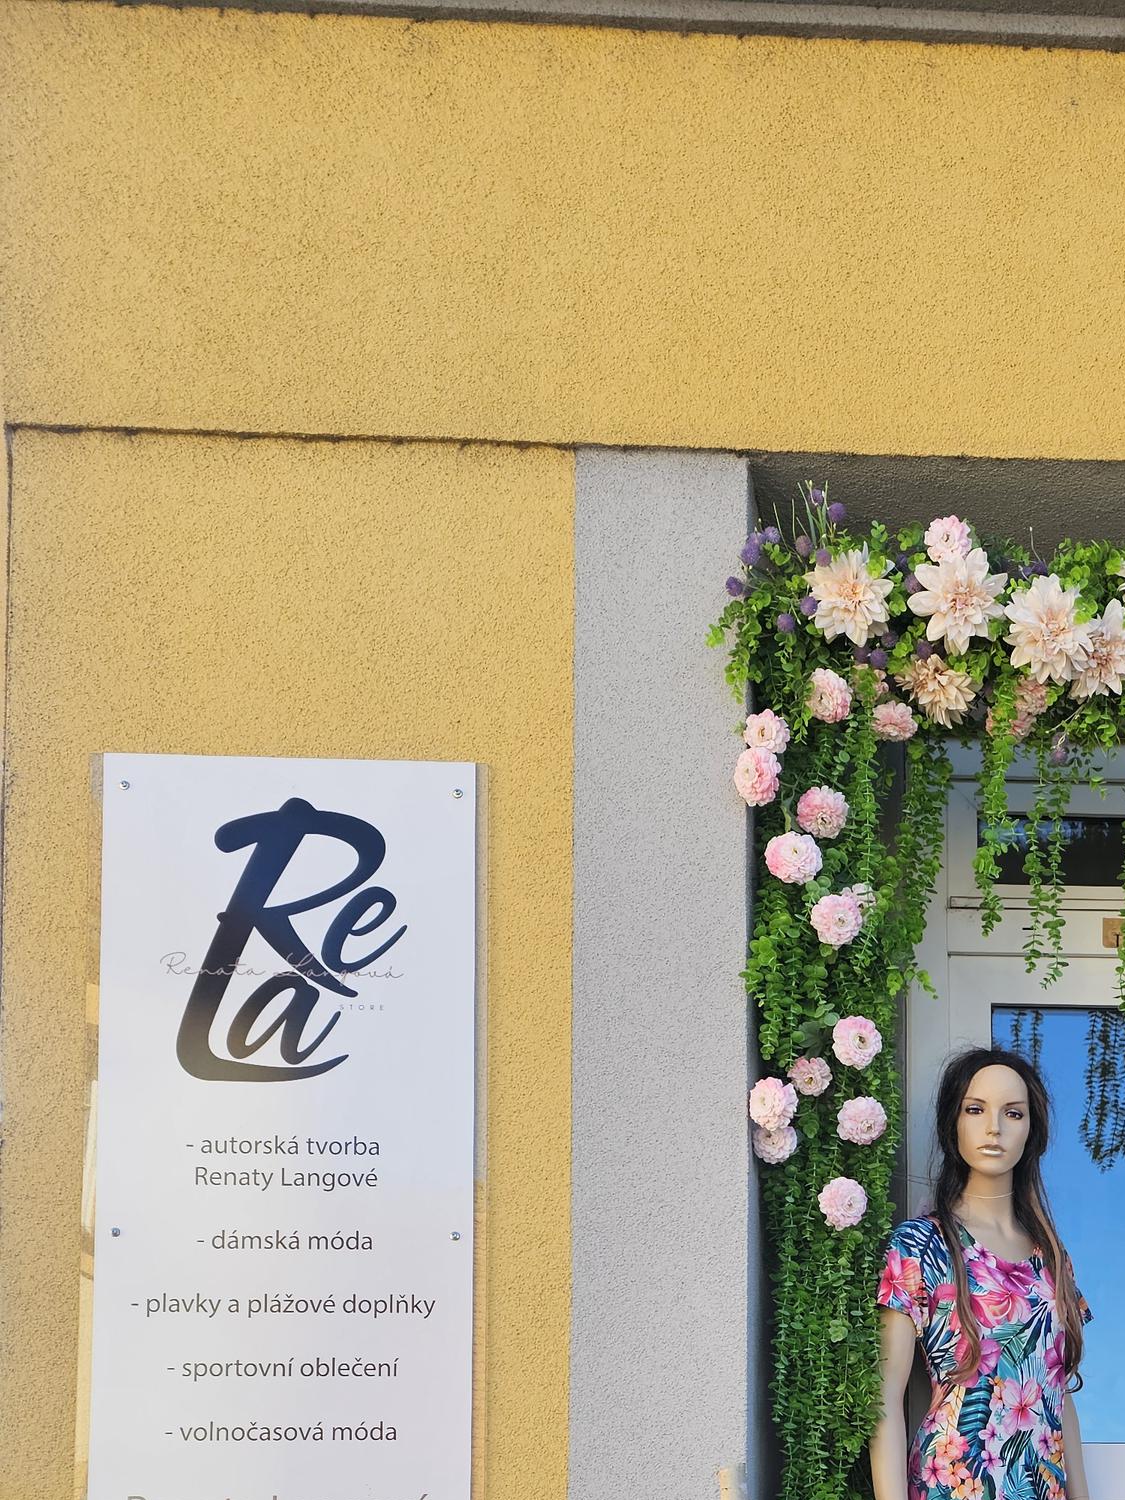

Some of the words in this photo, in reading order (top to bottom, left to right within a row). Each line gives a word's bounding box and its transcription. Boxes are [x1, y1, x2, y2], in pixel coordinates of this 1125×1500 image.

[213, 797, 408, 998] Re
[338, 1004, 385, 1012] STORE
[200, 1135, 299, 1155] autorská
[305, 1136, 380, 1156] tvorba
[195, 1166, 274, 1191] Renaty
[281, 1167, 378, 1192] Langové
[211, 1230, 300, 1250] dámská
[308, 1230, 373, 1251] móda
[146, 1293, 221, 1318] plavky
[228, 1299, 240, 1314] a
[248, 1294, 336, 1319] plážové
[342, 1294, 436, 1319] doplňky
[181, 1357, 294, 1382] sportovní
[300, 1357, 399, 1378] oblečení
[180, 1421, 324, 1442] volnočasová
[331, 1421, 397, 1441] móda
